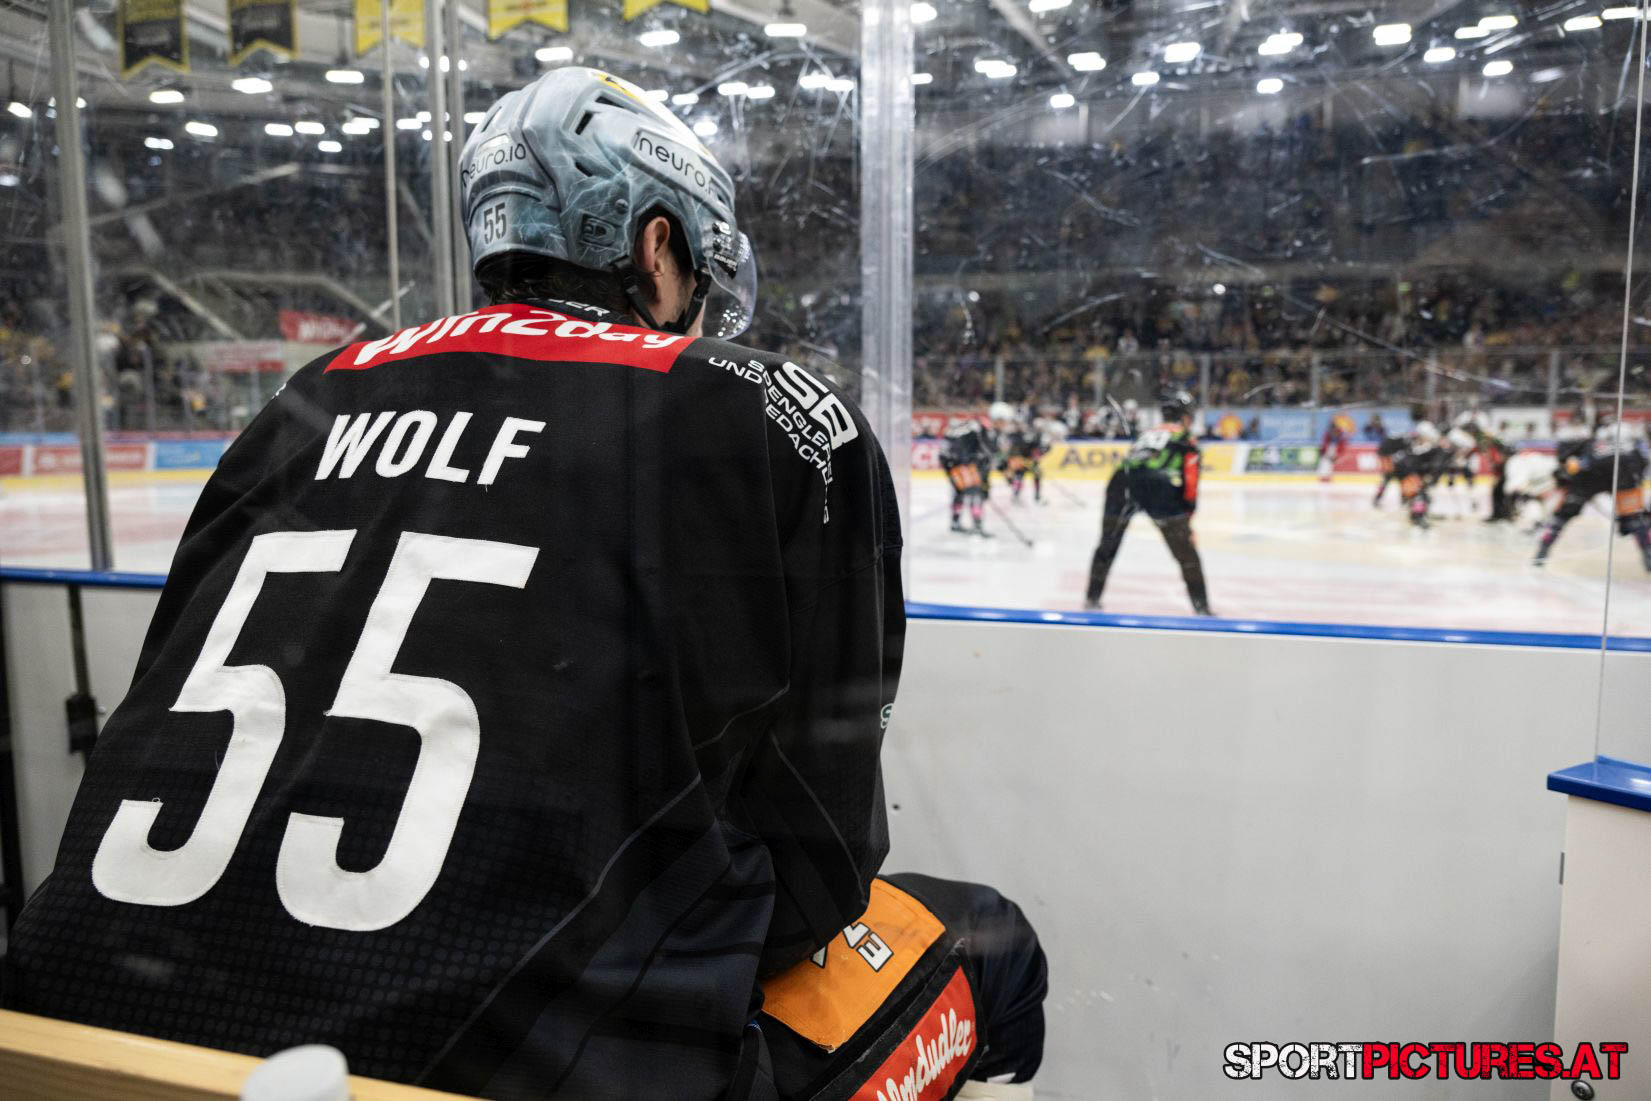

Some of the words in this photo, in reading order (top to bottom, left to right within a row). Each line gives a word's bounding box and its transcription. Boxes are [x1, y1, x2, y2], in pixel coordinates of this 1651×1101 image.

[483, 201, 507, 245] 55
[708, 356, 763, 385] UND
[314, 409, 546, 485] WOLF
[91, 529, 540, 931] 55
